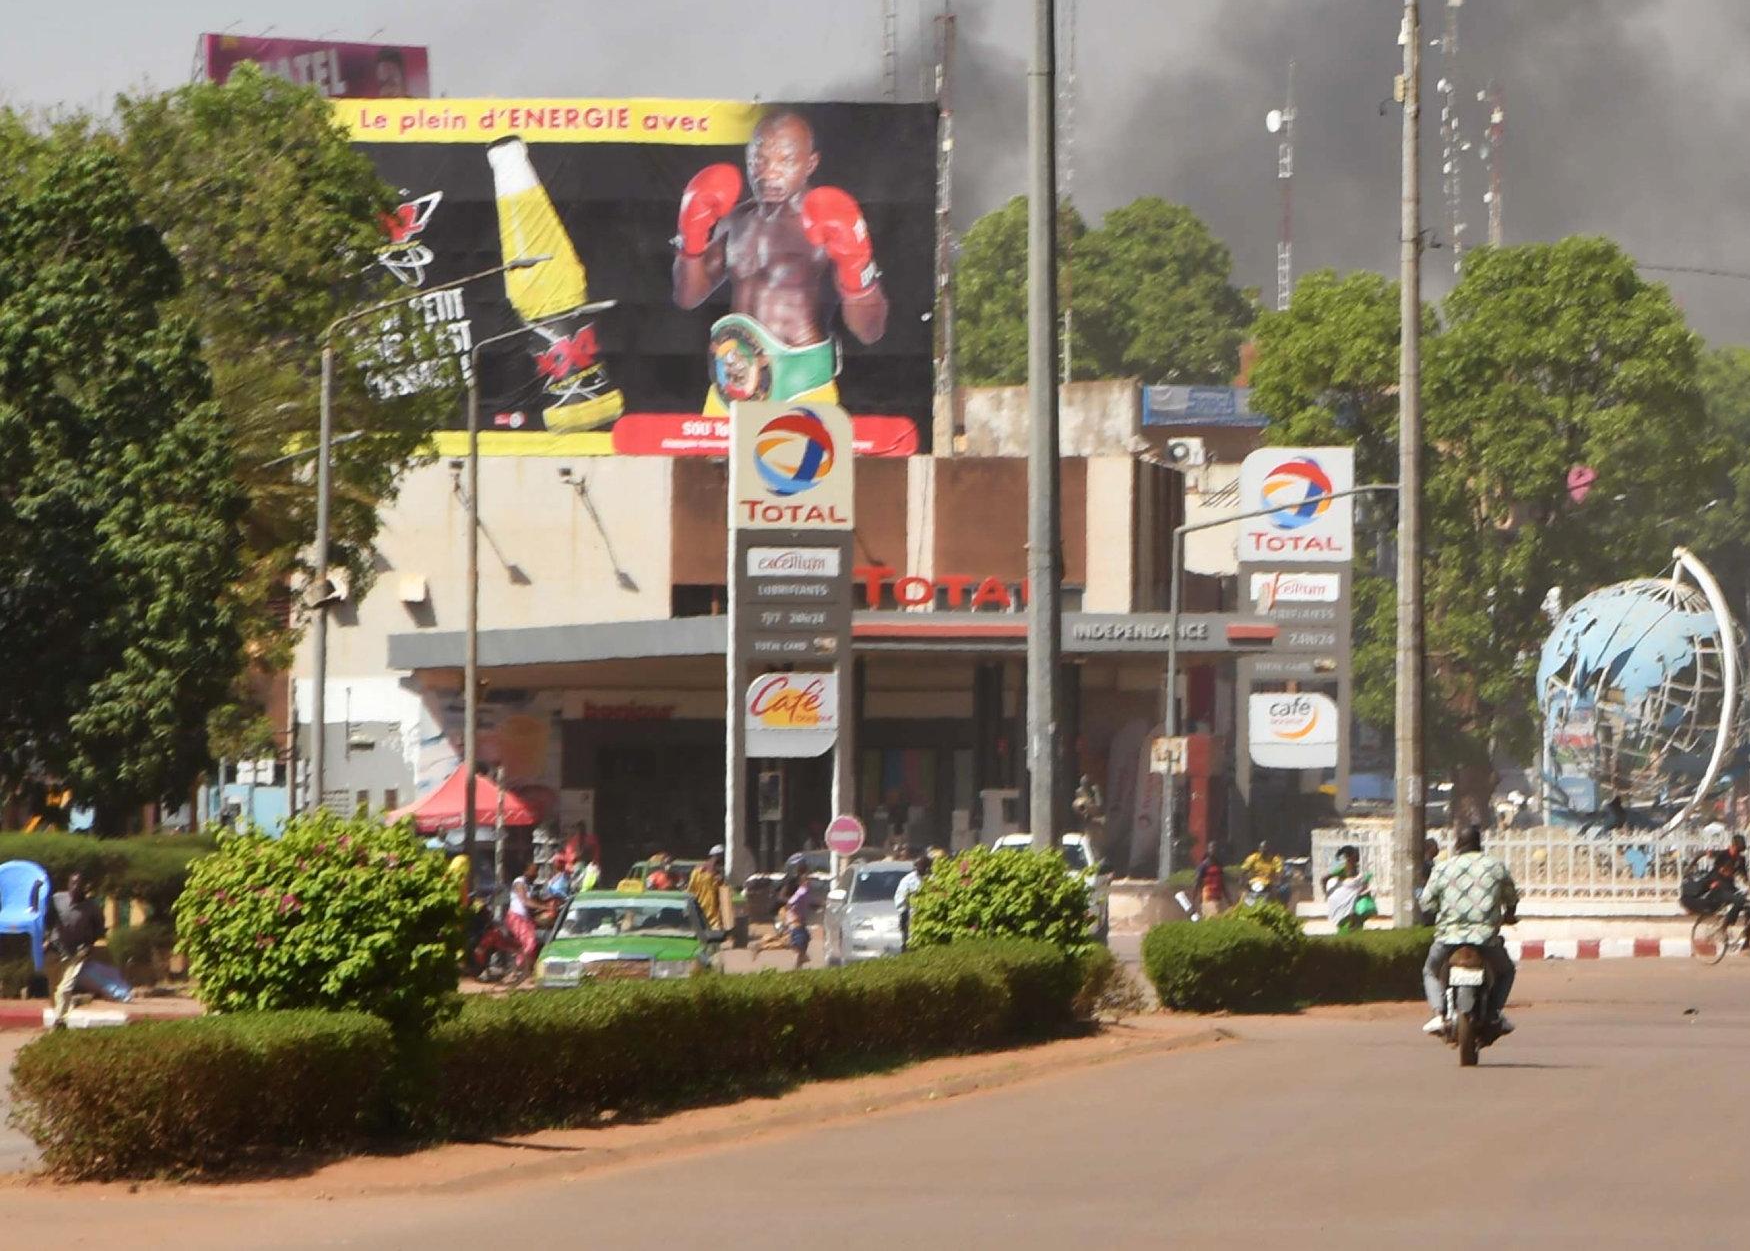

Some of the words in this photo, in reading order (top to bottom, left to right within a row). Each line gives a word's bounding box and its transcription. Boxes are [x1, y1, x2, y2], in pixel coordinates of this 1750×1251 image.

[360, 109, 388, 129] Le
[400, 108, 466, 135] plein
[479, 107, 630, 130] d'ENERGIE
[642, 114, 710, 132] avec
[740, 500, 848, 523] TOTAL
[1248, 532, 1343, 551] TOTAL
[751, 677, 825, 724] Café
[1269, 696, 1311, 717] café
